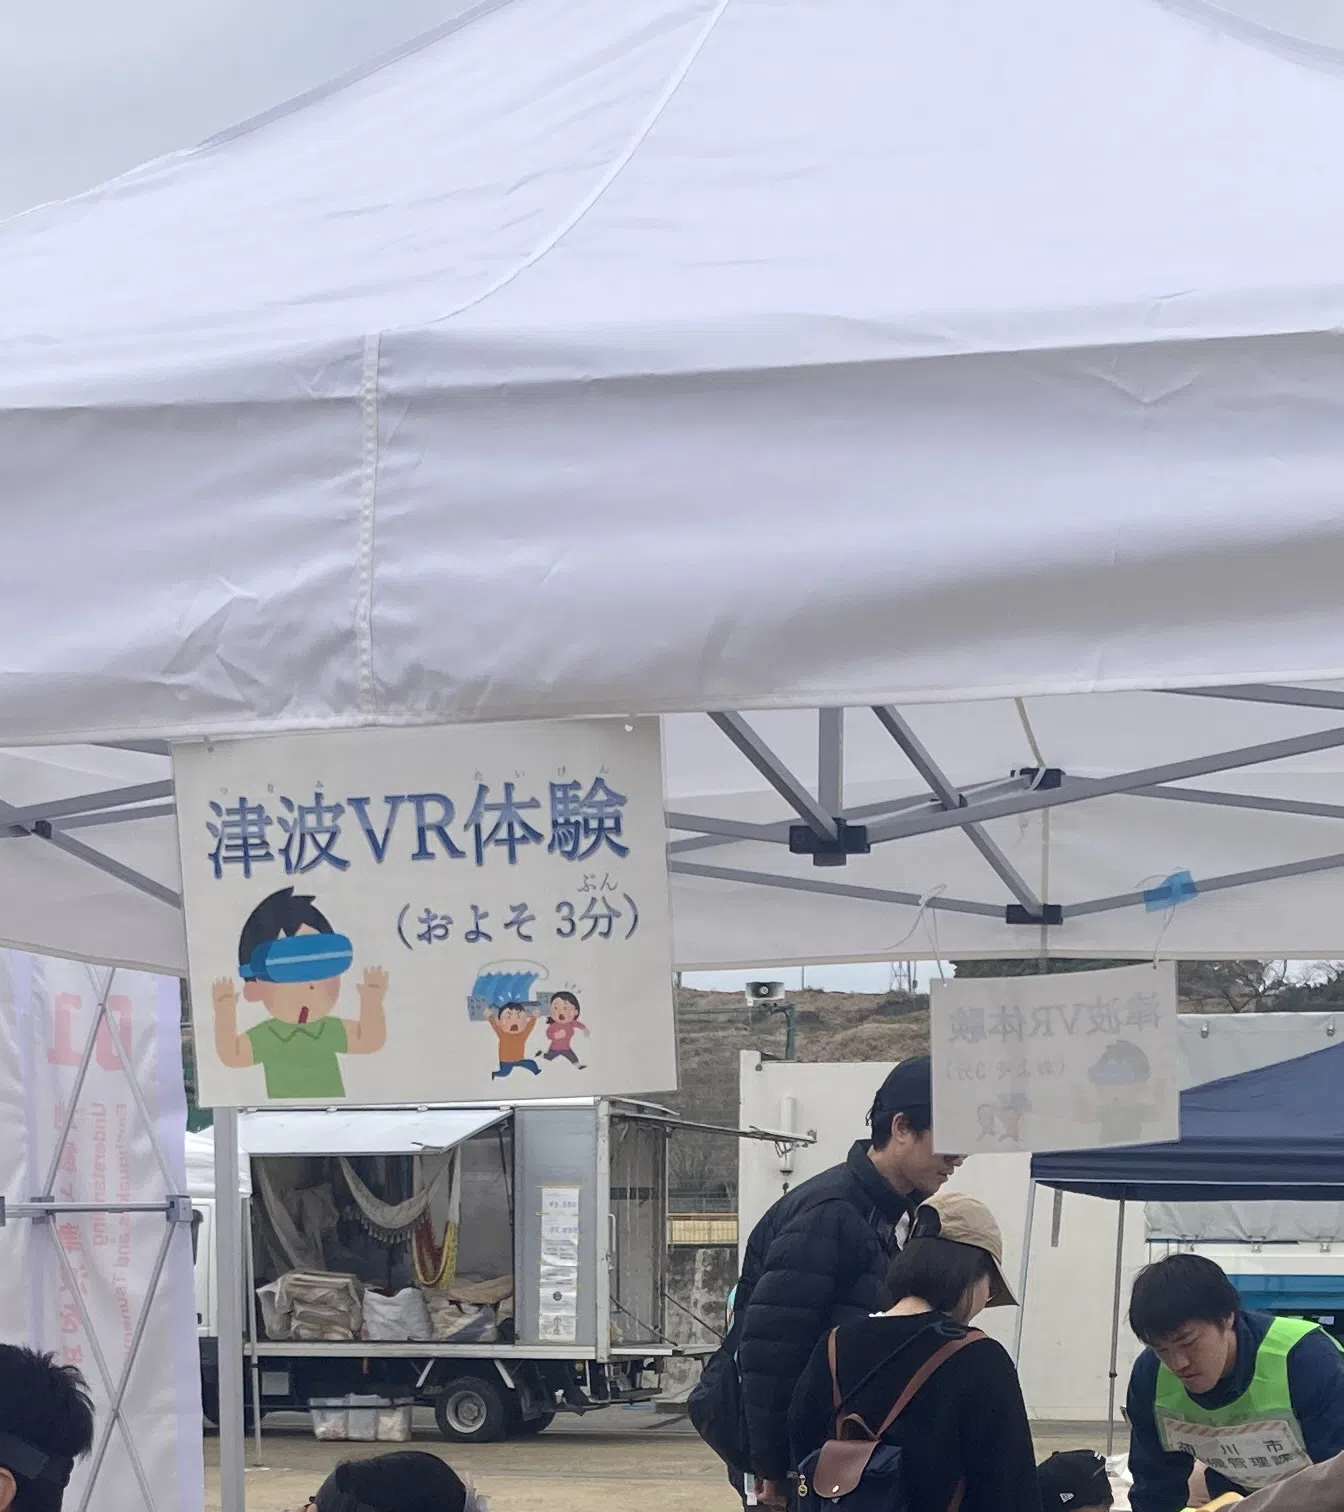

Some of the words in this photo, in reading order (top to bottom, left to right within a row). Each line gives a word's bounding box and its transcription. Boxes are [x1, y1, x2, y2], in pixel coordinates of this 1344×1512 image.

[206, 777, 630, 880] 津波VR体験
[577, 872, 619, 892] ぶん
